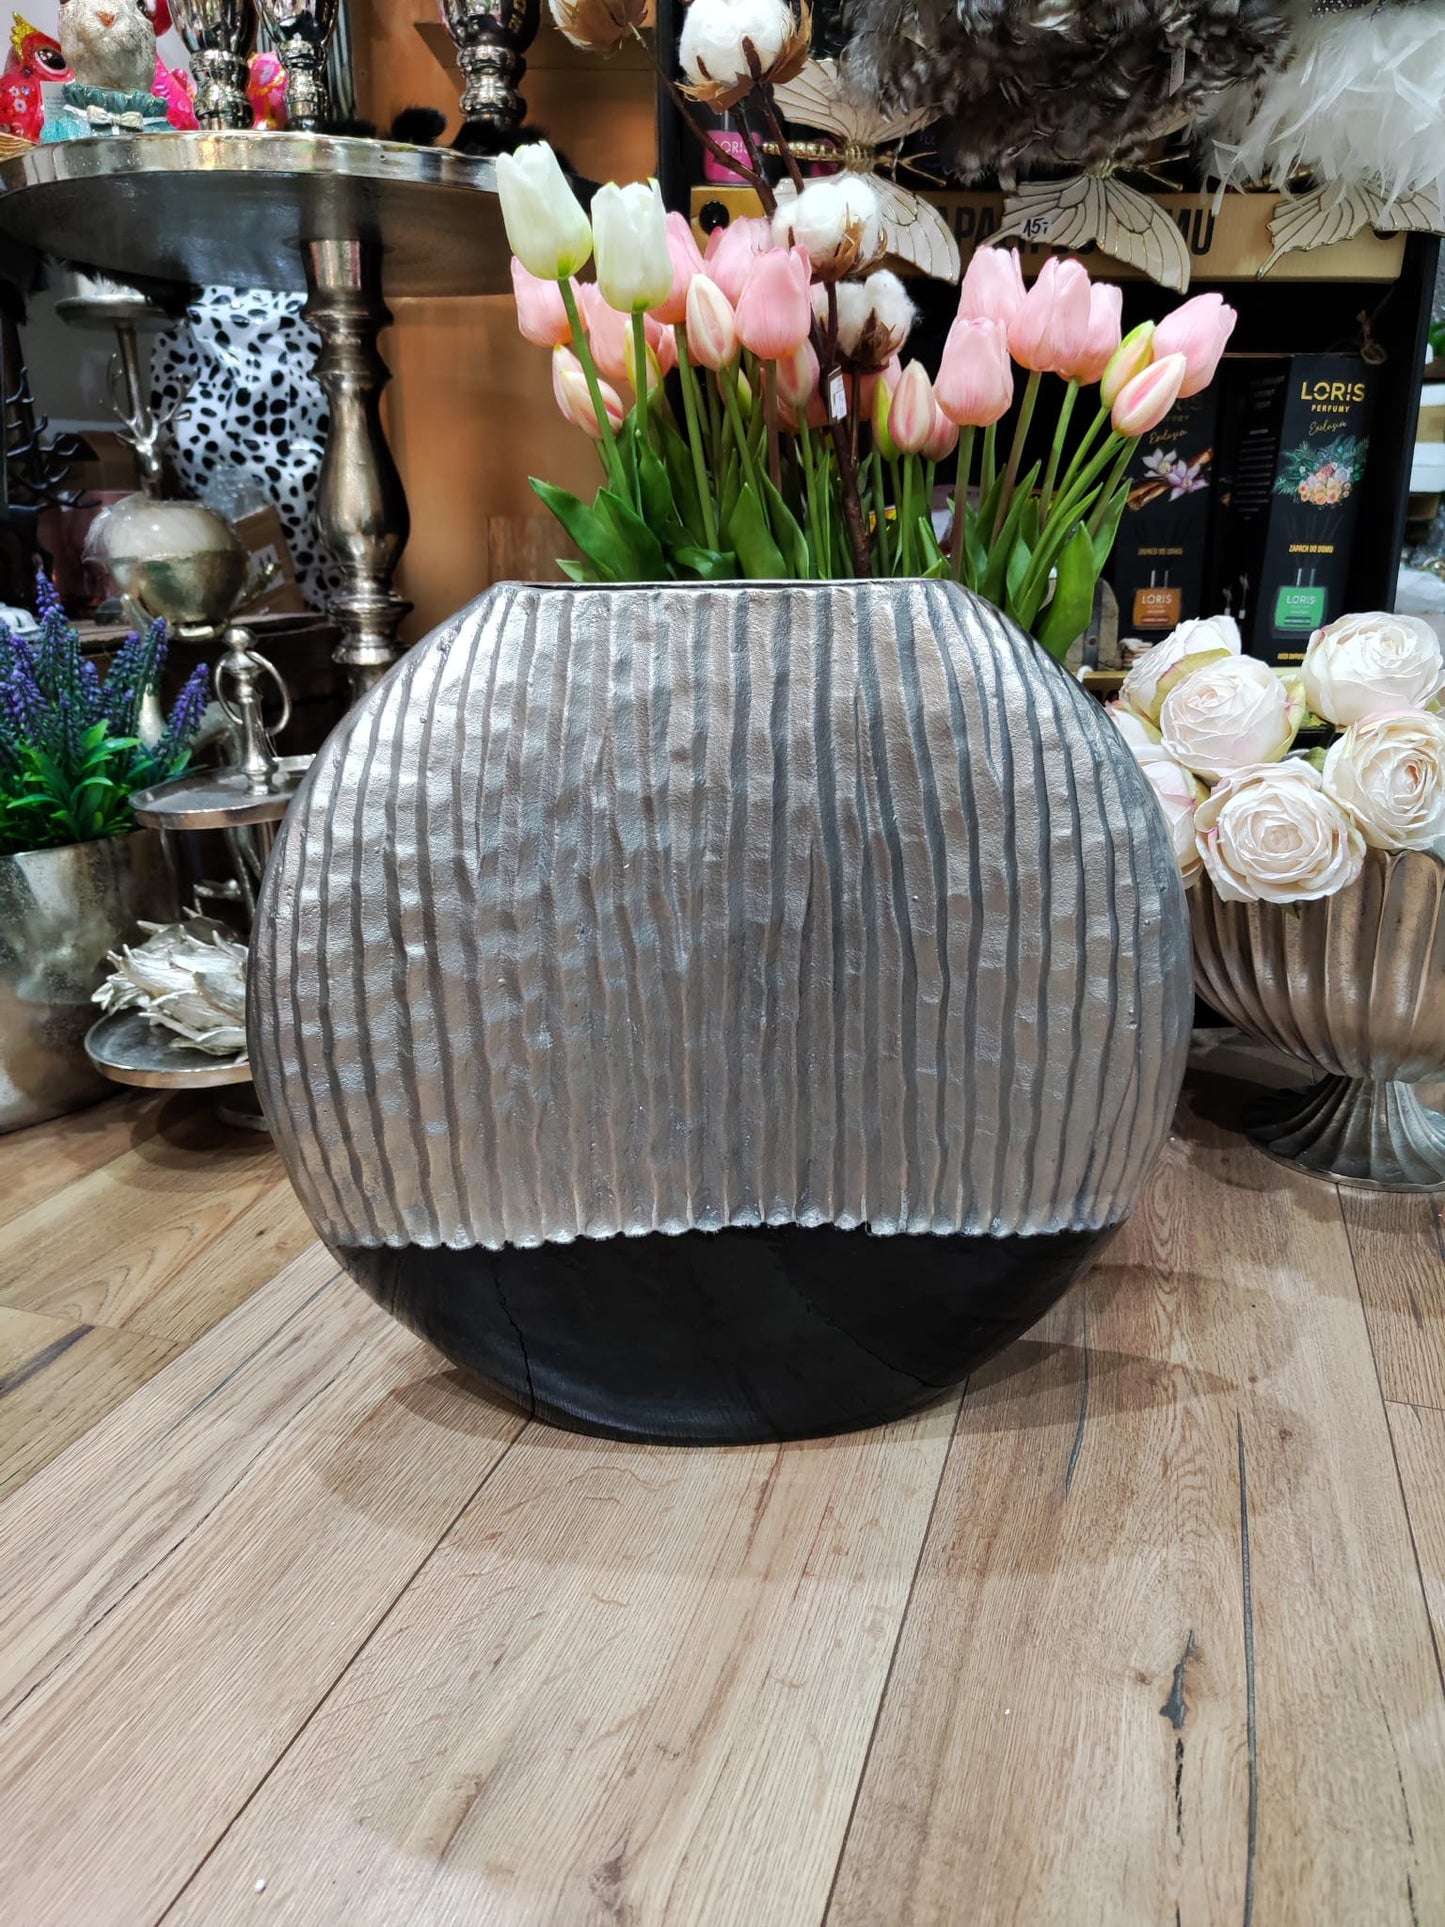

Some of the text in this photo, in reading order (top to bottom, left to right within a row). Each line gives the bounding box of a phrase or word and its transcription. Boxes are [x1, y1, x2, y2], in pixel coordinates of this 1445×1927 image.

[714, 140, 748, 154] ORI
[1300, 381, 1365, 402] LORIS
[1311, 404, 1350, 413] PERFUMY
[1142, 594, 1172, 605] LORIS
[1286, 595, 1316, 605] LORIS
